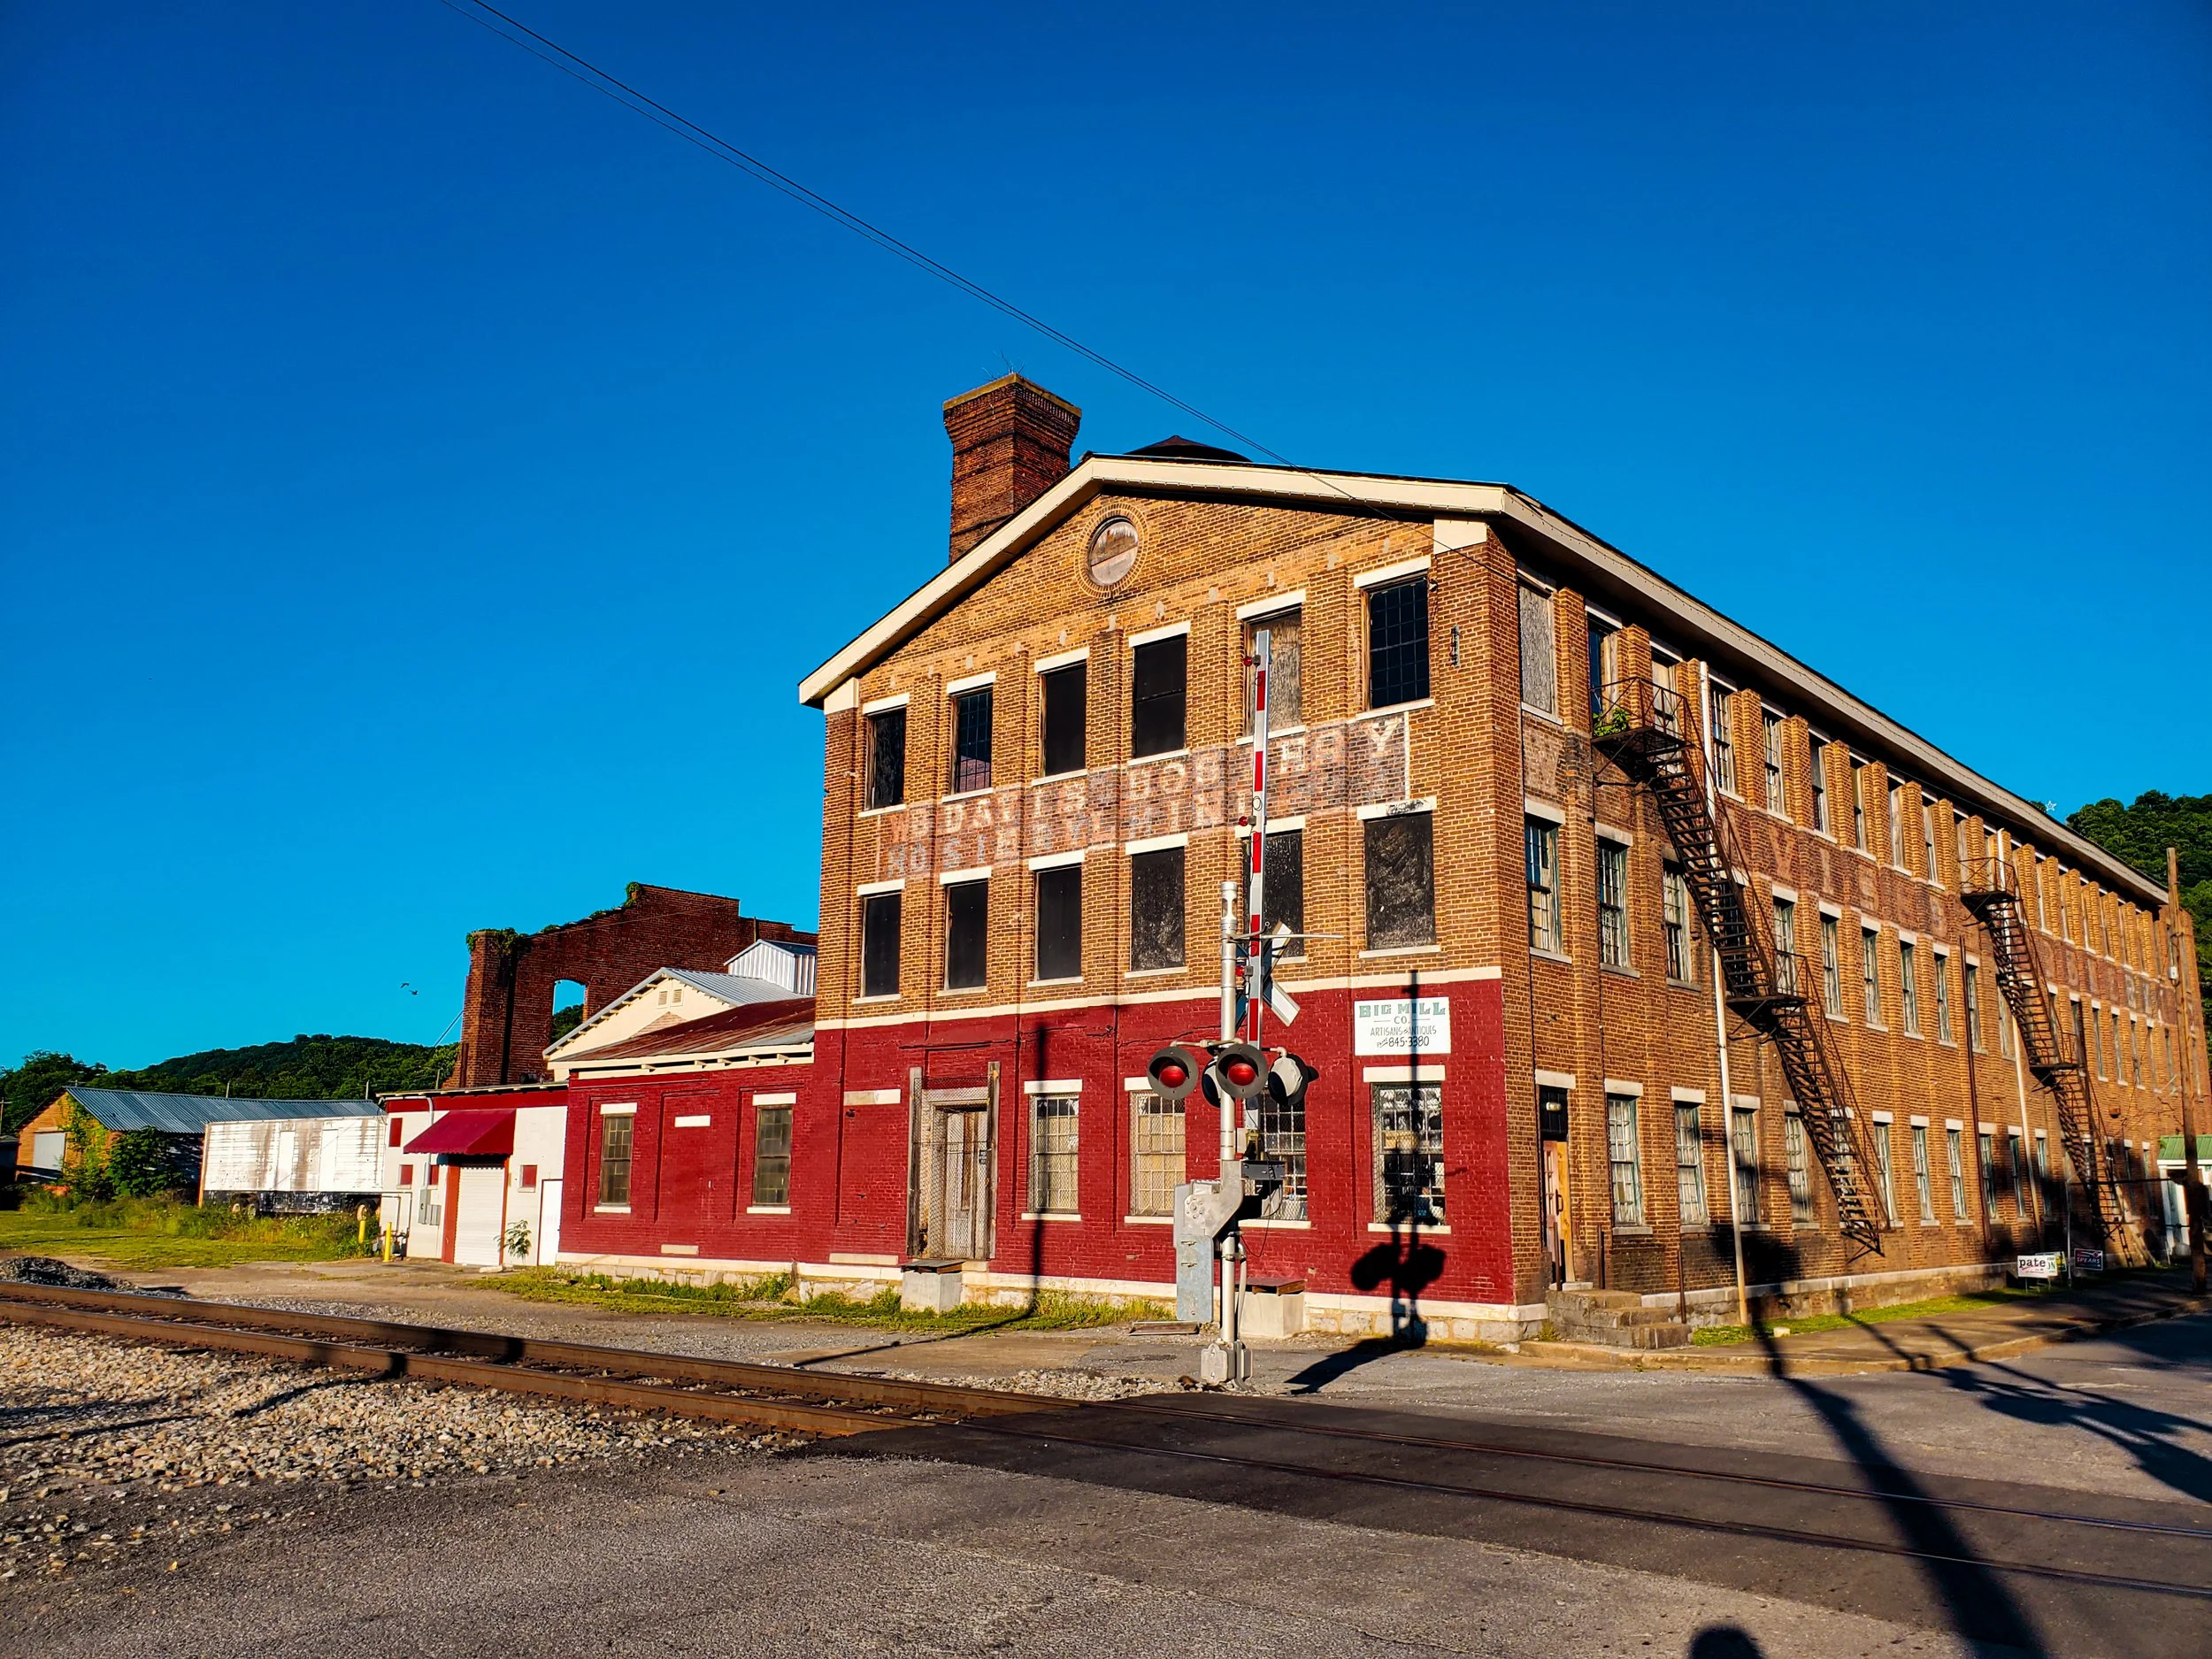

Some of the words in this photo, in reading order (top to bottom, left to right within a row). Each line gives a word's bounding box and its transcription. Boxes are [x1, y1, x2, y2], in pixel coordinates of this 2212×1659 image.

[1359, 1004, 1392, 1018] BIG
[1397, 1002, 1446, 1015] MILL
[1394, 1016, 1410, 1025] CO.
[1371, 1026, 1403, 1036] ARTISANS
[1408, 1025, 1437, 1035] ANTIQUES
[2019, 1257, 2046, 1268] pate
